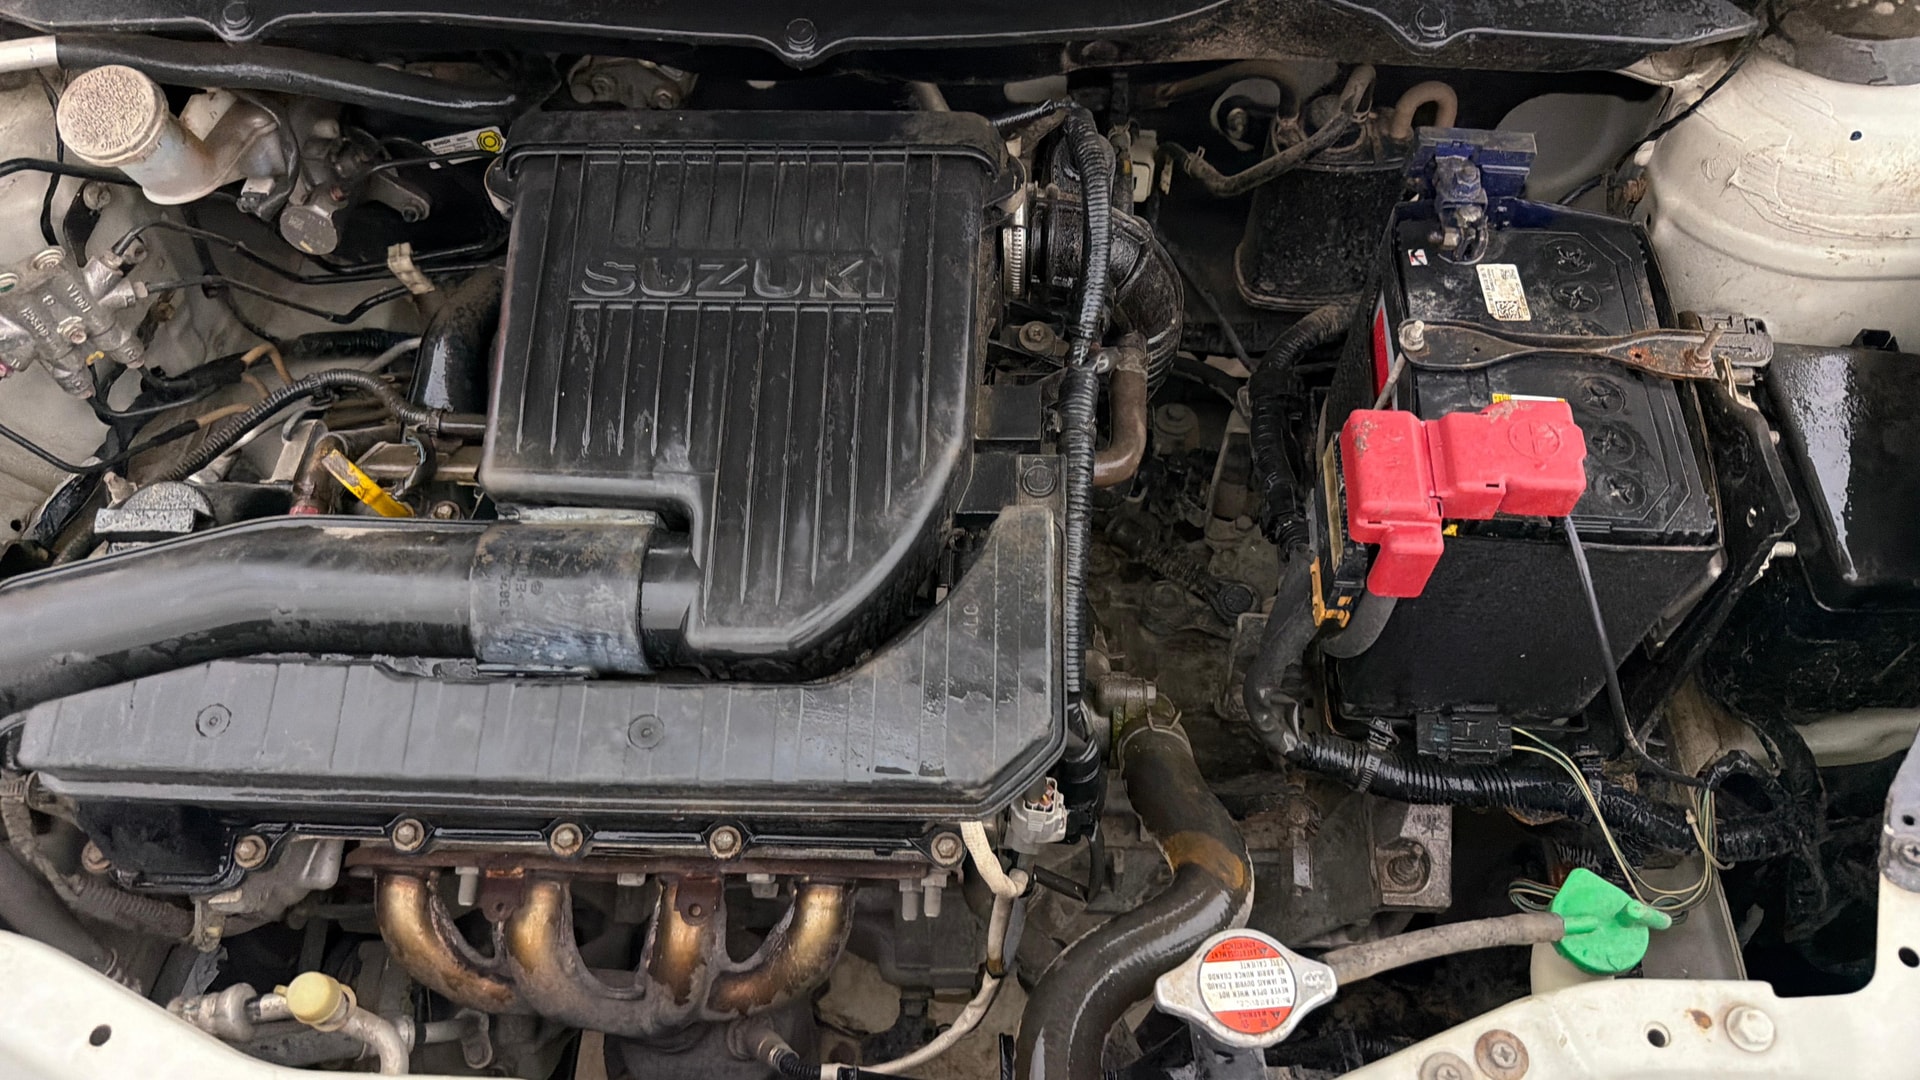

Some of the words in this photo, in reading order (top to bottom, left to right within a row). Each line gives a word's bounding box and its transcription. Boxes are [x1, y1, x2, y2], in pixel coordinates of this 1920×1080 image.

[581, 257, 887, 298] SUZUKI
[1240, 960, 1267, 970] CALIENTE
[1208, 972, 1232, 981] CUANDO
[1234, 971, 1255, 979] NUNCA
[1257, 969, 1275, 977] ABRIR
[1235, 980, 1255, 989] OUVRIR
[1257, 979, 1278, 987] JAMAIS
[1280, 977, 1287, 985] NE
[1233, 990, 1250, 998] WHEN
[1252, 988, 1268, 997] OPEN
[1270, 987, 1289, 995] NEVER
